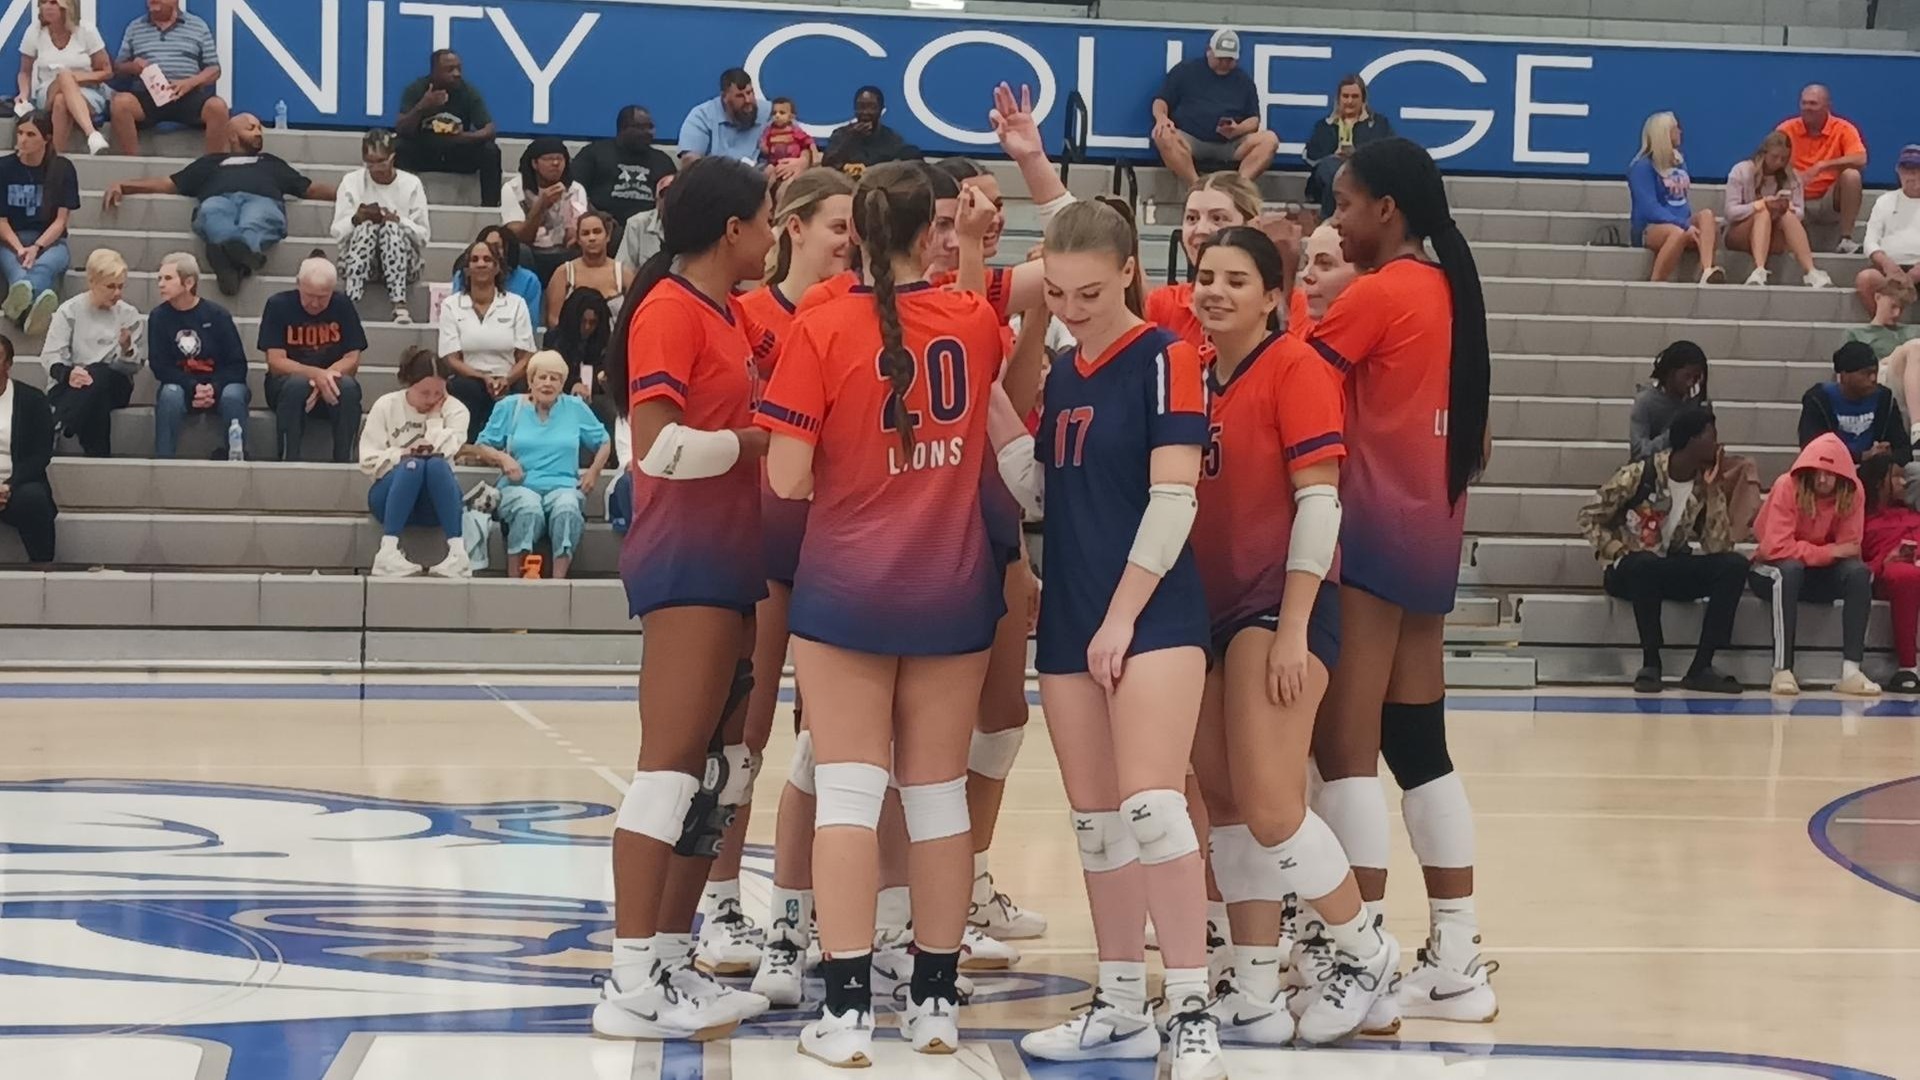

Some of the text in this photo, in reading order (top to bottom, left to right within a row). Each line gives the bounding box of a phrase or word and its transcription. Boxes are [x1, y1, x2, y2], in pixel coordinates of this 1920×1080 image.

[742, 22, 1593, 164] COLEGE
[287, 321, 341, 346] LIONS
[875, 335, 970, 433] 20
[889, 436, 963, 475] LONS
[1055, 405, 1094, 468] 17
